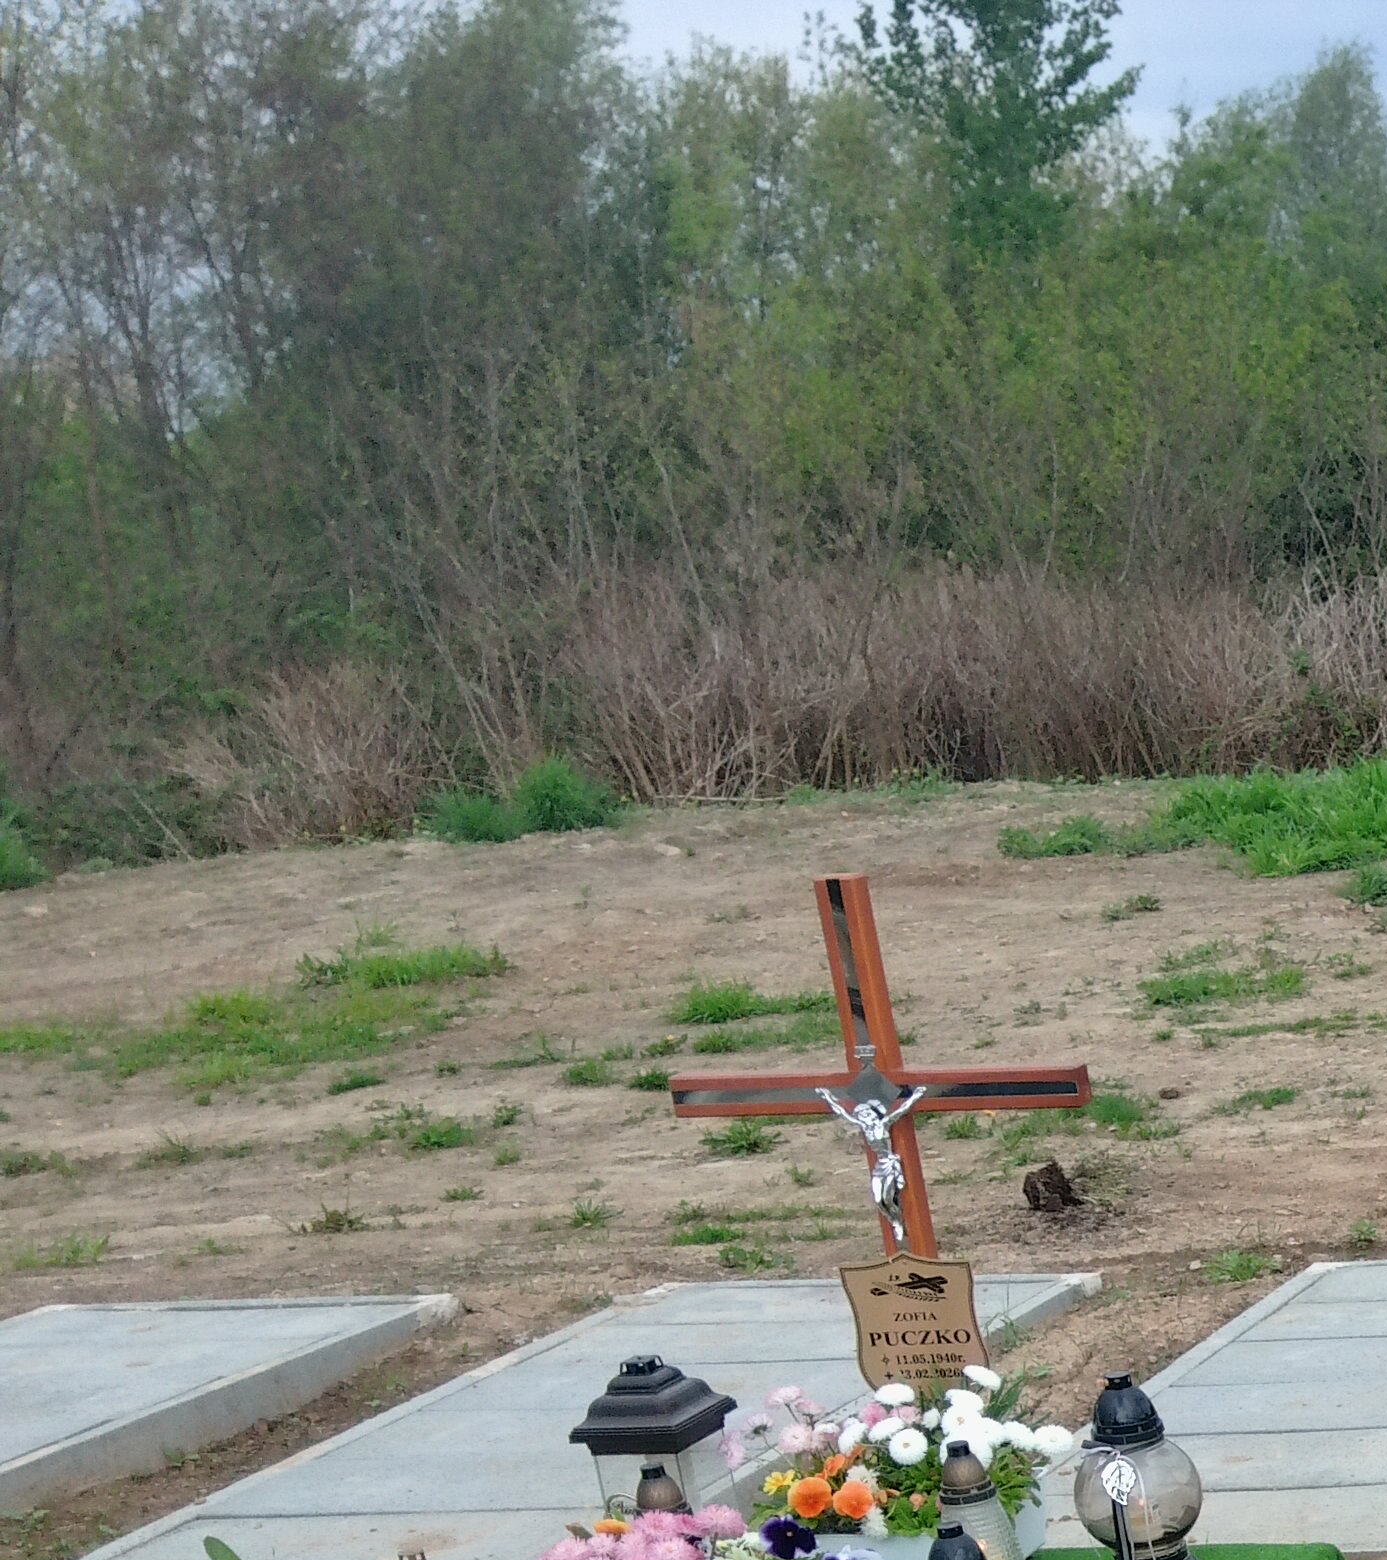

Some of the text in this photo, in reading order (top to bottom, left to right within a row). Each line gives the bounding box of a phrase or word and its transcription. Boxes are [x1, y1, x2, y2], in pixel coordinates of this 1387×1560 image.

[893, 1312, 937, 1322] ZOFIA
[868, 1328, 971, 1347] PUCZKO
[895, 1353, 966, 1365] 11.05.1940r.
